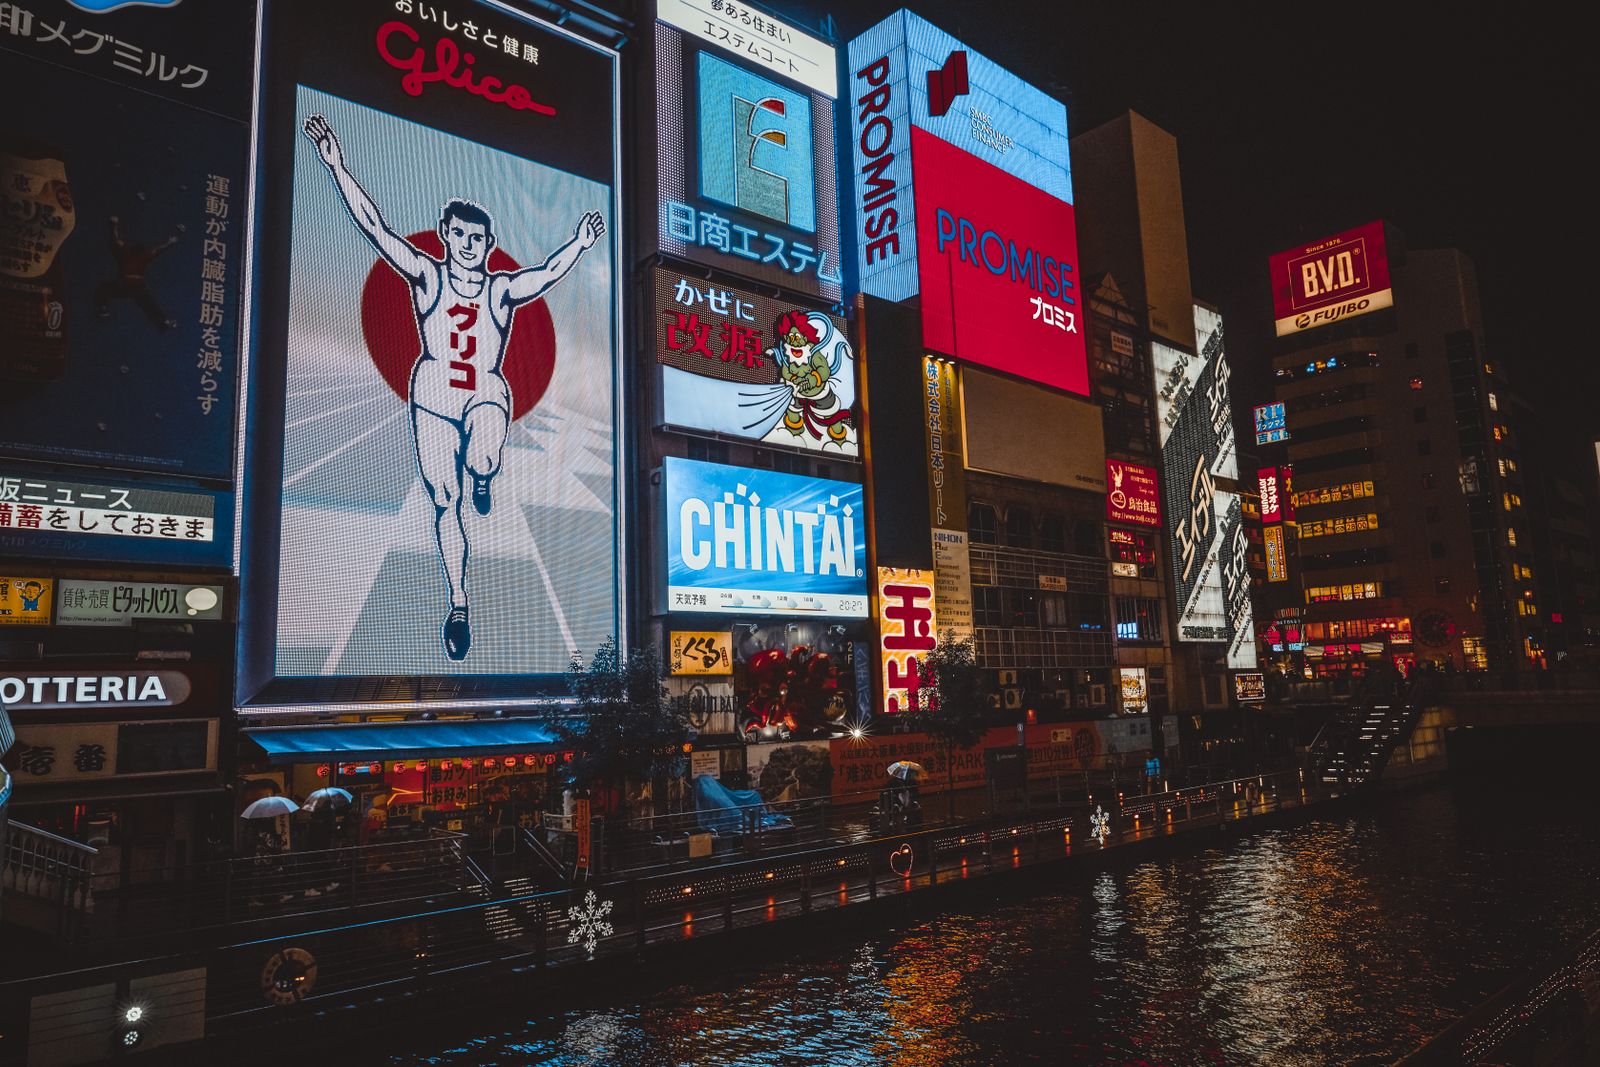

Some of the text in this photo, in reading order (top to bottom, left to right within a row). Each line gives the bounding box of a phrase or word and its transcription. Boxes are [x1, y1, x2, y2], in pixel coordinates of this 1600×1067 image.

[395, 0, 540, 66] おいしさと健康
[711, 0, 791, 44] 夢ある住まい
[0, 2, 209, 90] 印メグミルク
[703, 20, 799, 73] エステムコート
[376, 20, 556, 116] Glico
[969, 106, 993, 127] SMBC
[970, 118, 1015, 150] CONSUMER
[857, 55, 900, 266] PROMISE
[971, 130, 1007, 155] FINANCE
[667, 201, 842, 284] 日商エステム
[936, 207, 1075, 305] PROMISE
[1306, 244, 1324, 254] Since
[197, 173, 231, 416] 運動が内臓脂肪を減らす
[1301, 250, 1361, 298] B.V.D.
[674, 279, 756, 321] かぜに
[1029, 297, 1077, 334] プロミス
[1313, 299, 1370, 323] FUJIBO
[447, 302, 483, 391] グリコ
[664, 310, 764, 369] 改源
[0, 477, 132, 510] 阪ニュース
[1176, 463, 1216, 566] エイブル
[1267, 476, 1280, 514] カラオケ
[0, 503, 205, 539] 備蓄をしておきま
[680, 483, 856, 577] CHINTAI
[934, 532, 963, 544] NIHON
[112, 586, 179, 614] ピタットハウス
[676, 593, 707, 606] 天気予報
[682, 637, 720, 668] くくる
[0, 675, 167, 704] OTTERIA
